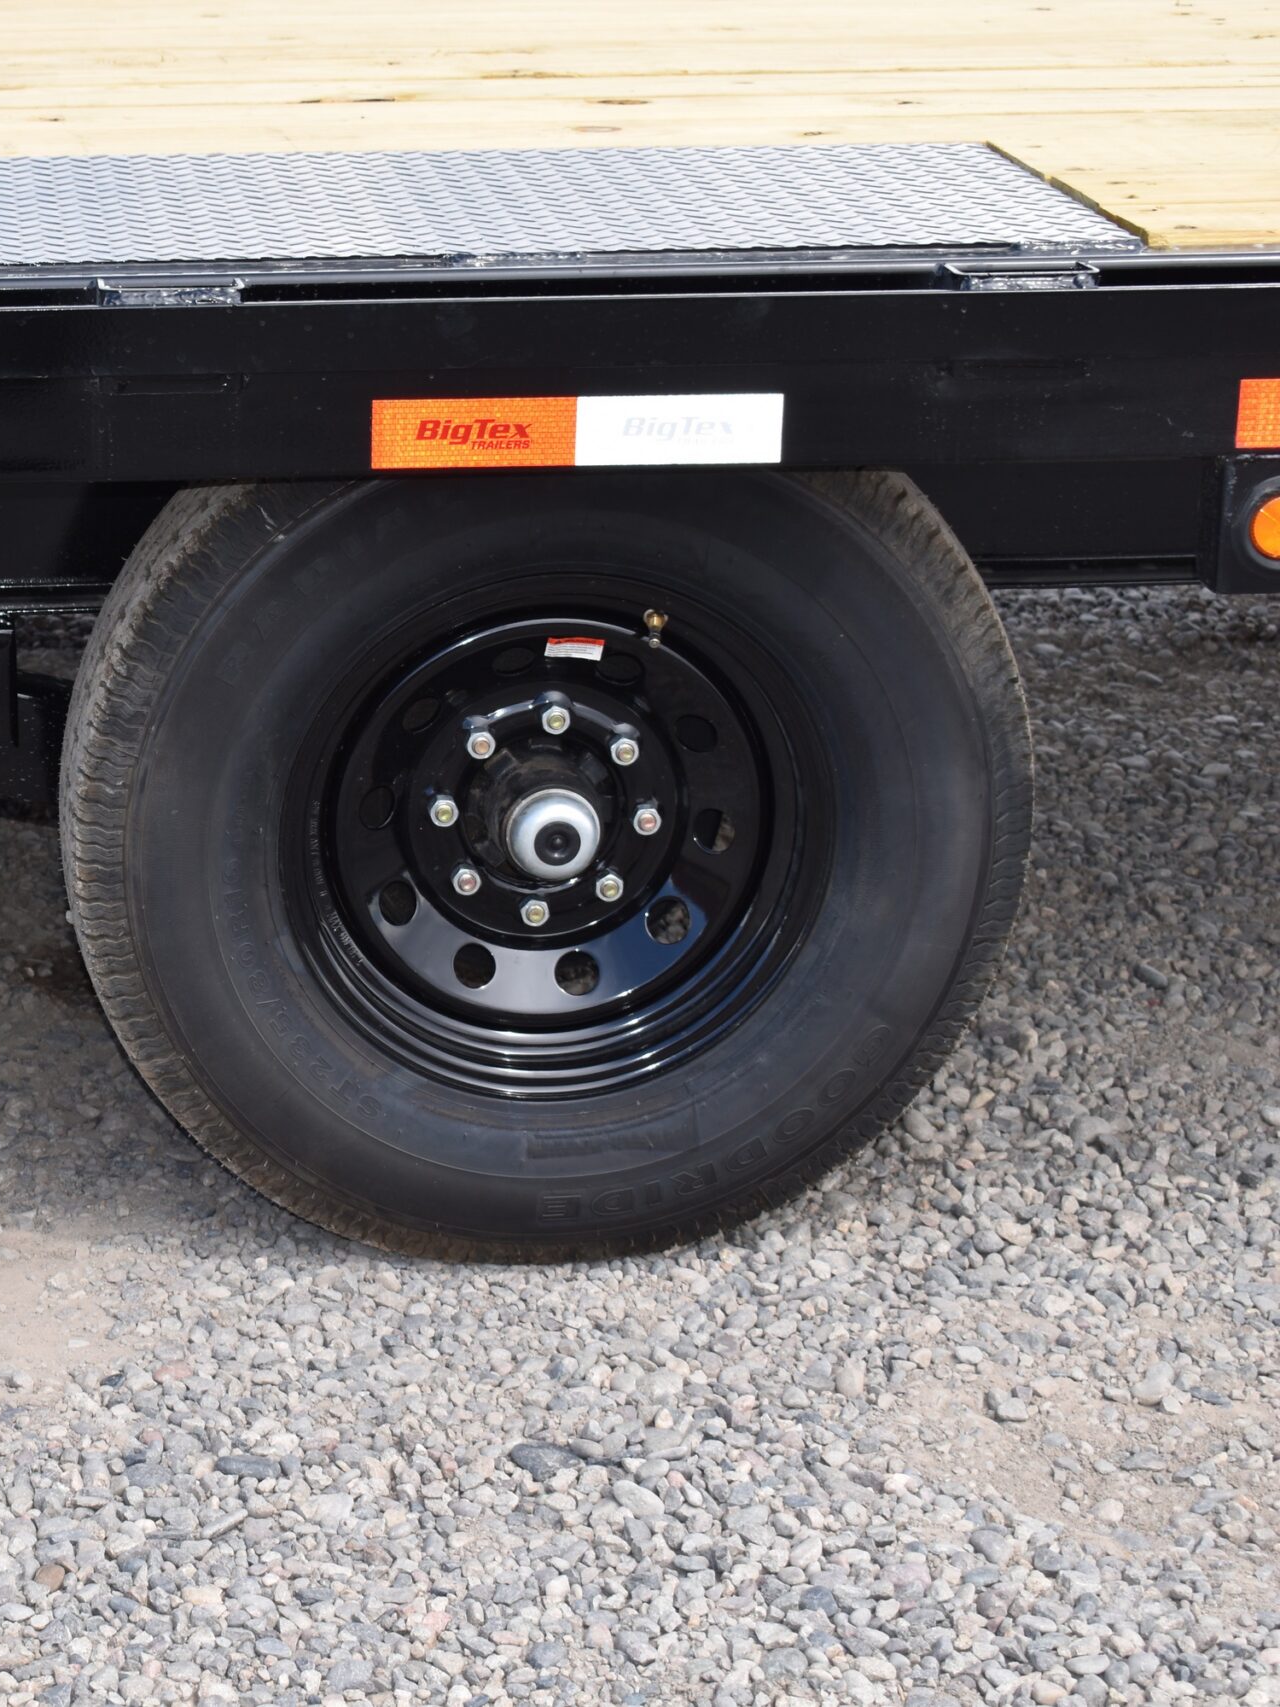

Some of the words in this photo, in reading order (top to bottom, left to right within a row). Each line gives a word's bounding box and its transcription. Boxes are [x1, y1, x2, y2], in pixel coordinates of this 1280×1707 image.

[415, 418, 532, 445] BigTex
[622, 416, 734, 442] BigTex
[471, 439, 532, 451] TRAILERS
[538, 1023, 891, 1223] GOODRIDE
